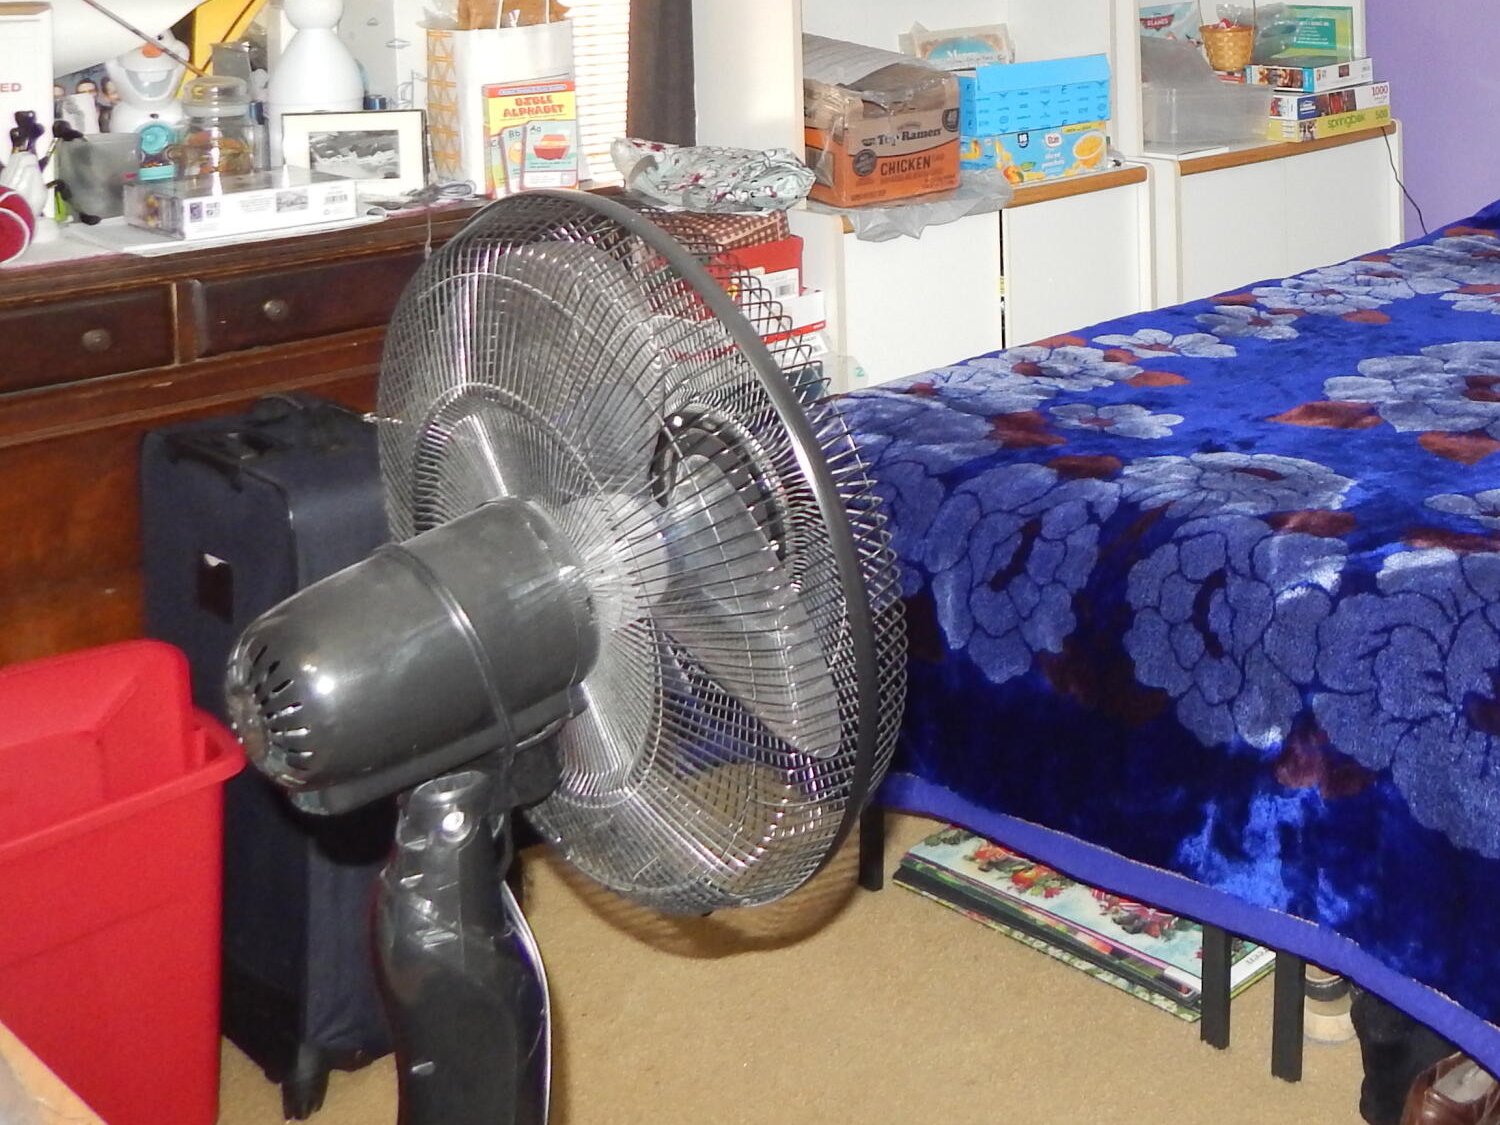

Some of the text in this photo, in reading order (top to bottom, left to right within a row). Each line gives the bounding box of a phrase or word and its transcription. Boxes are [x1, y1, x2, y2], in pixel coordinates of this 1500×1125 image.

[1371, 84, 1388, 96] 1000
[515, 94, 553, 107] BIBLE
[503, 103, 564, 118] ALPHABET
[529, 124, 542, 133] Aa
[901, 127, 942, 142] Ramen
[880, 154, 932, 176] CHICKEN
